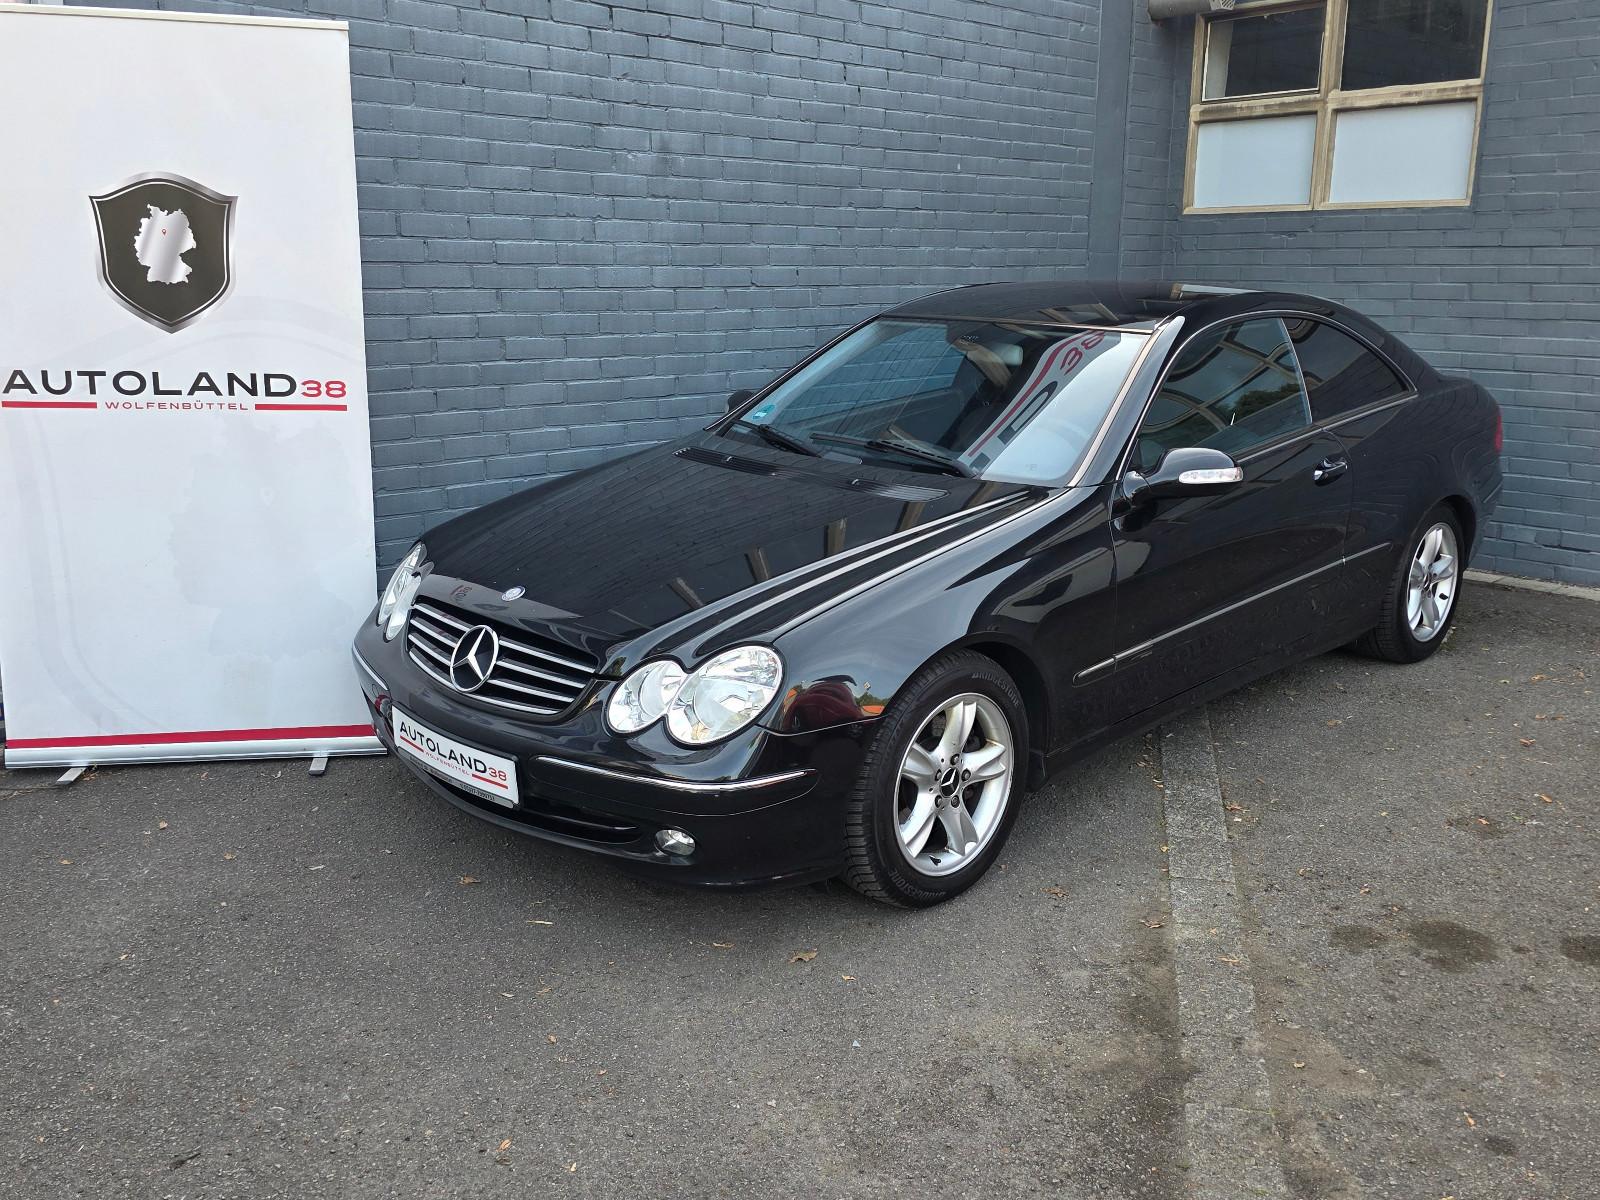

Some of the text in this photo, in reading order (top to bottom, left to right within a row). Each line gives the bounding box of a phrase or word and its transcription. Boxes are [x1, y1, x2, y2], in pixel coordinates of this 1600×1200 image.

[2, 369, 347, 398] AUTOLAND38
[105, 400, 249, 411] WOLFENBÜTTEL
[971, 671, 1020, 707] BRIDGESTONE
[399, 721, 508, 782] AUTOLAND38
